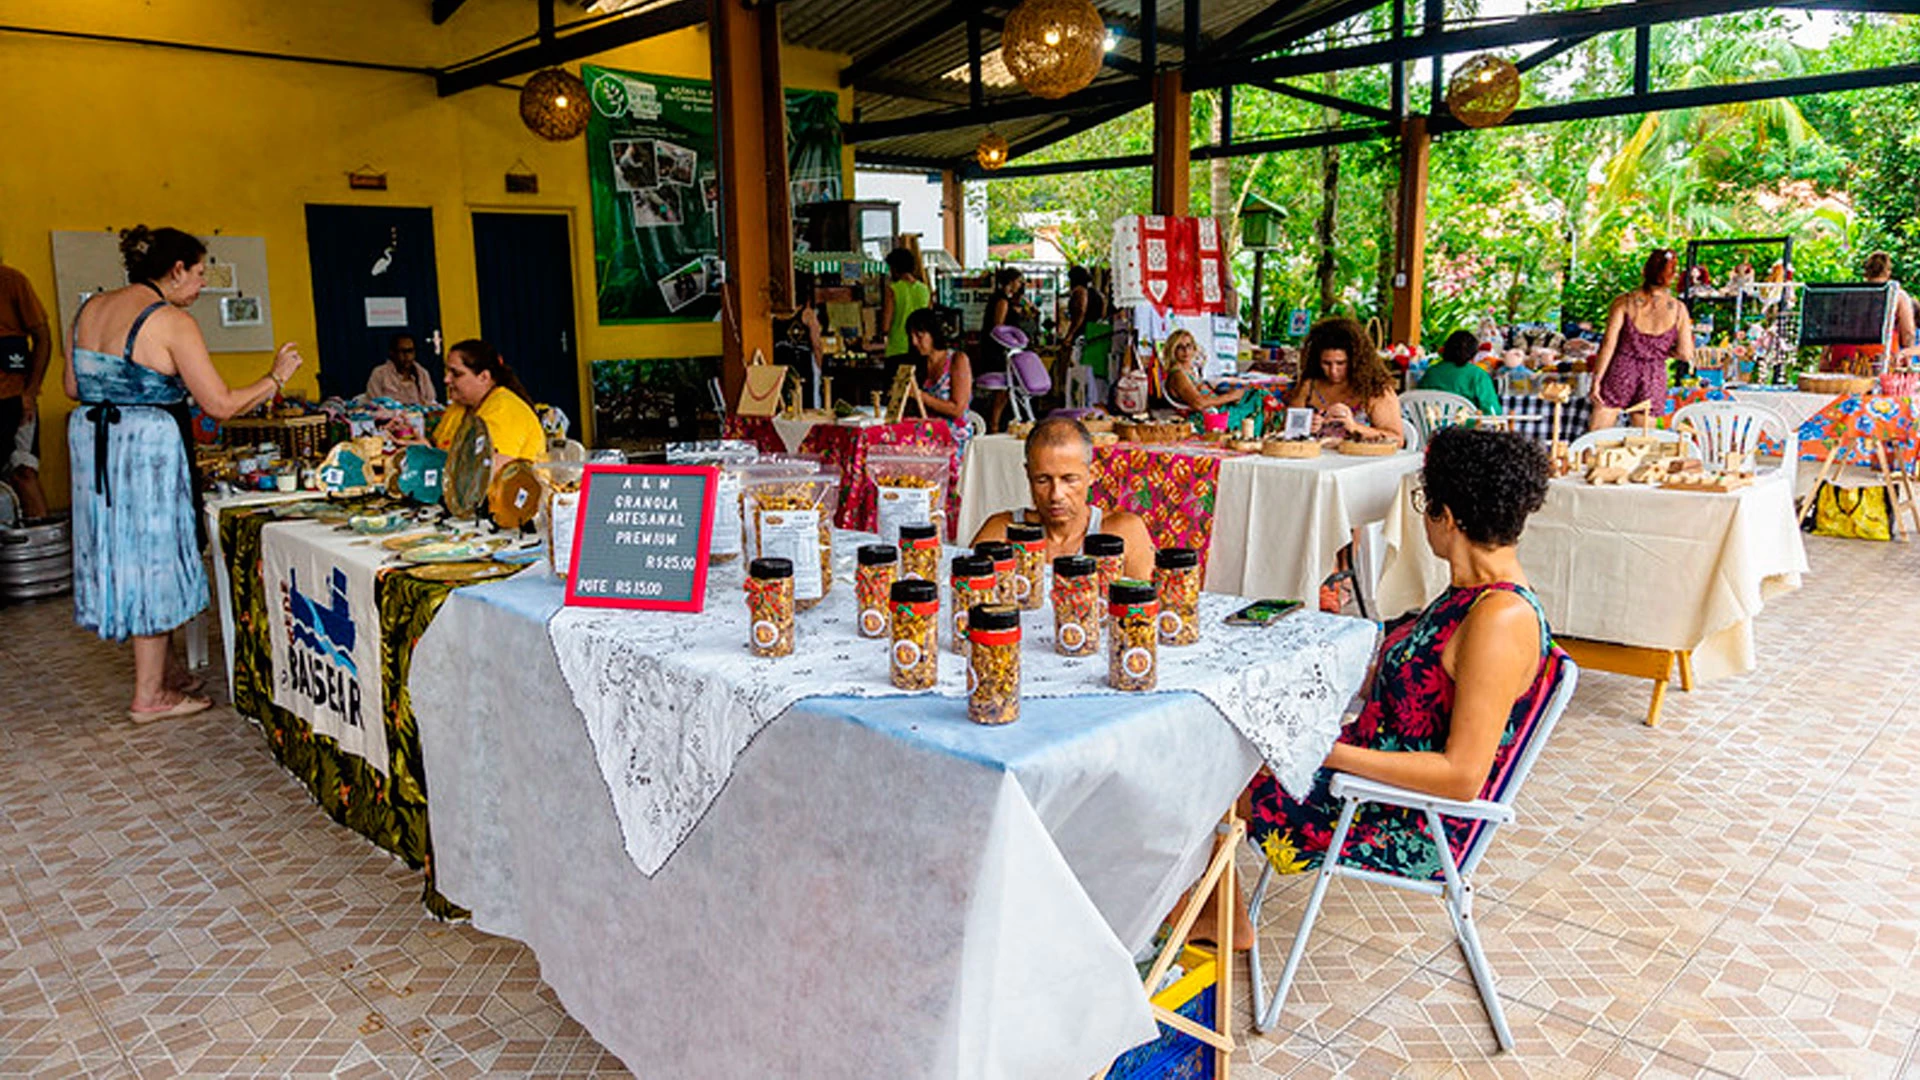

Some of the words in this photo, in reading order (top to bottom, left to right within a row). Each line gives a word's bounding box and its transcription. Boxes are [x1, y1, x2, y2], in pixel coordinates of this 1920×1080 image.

[622, 477, 632, 489] A
[642, 477, 650, 489] &
[659, 477, 670, 490] M
[614, 495, 678, 509] GRANOLA
[606, 512, 684, 527] ARTESANAL
[615, 531, 677, 546] PREMIUM
[577, 579, 608, 593] POTE
